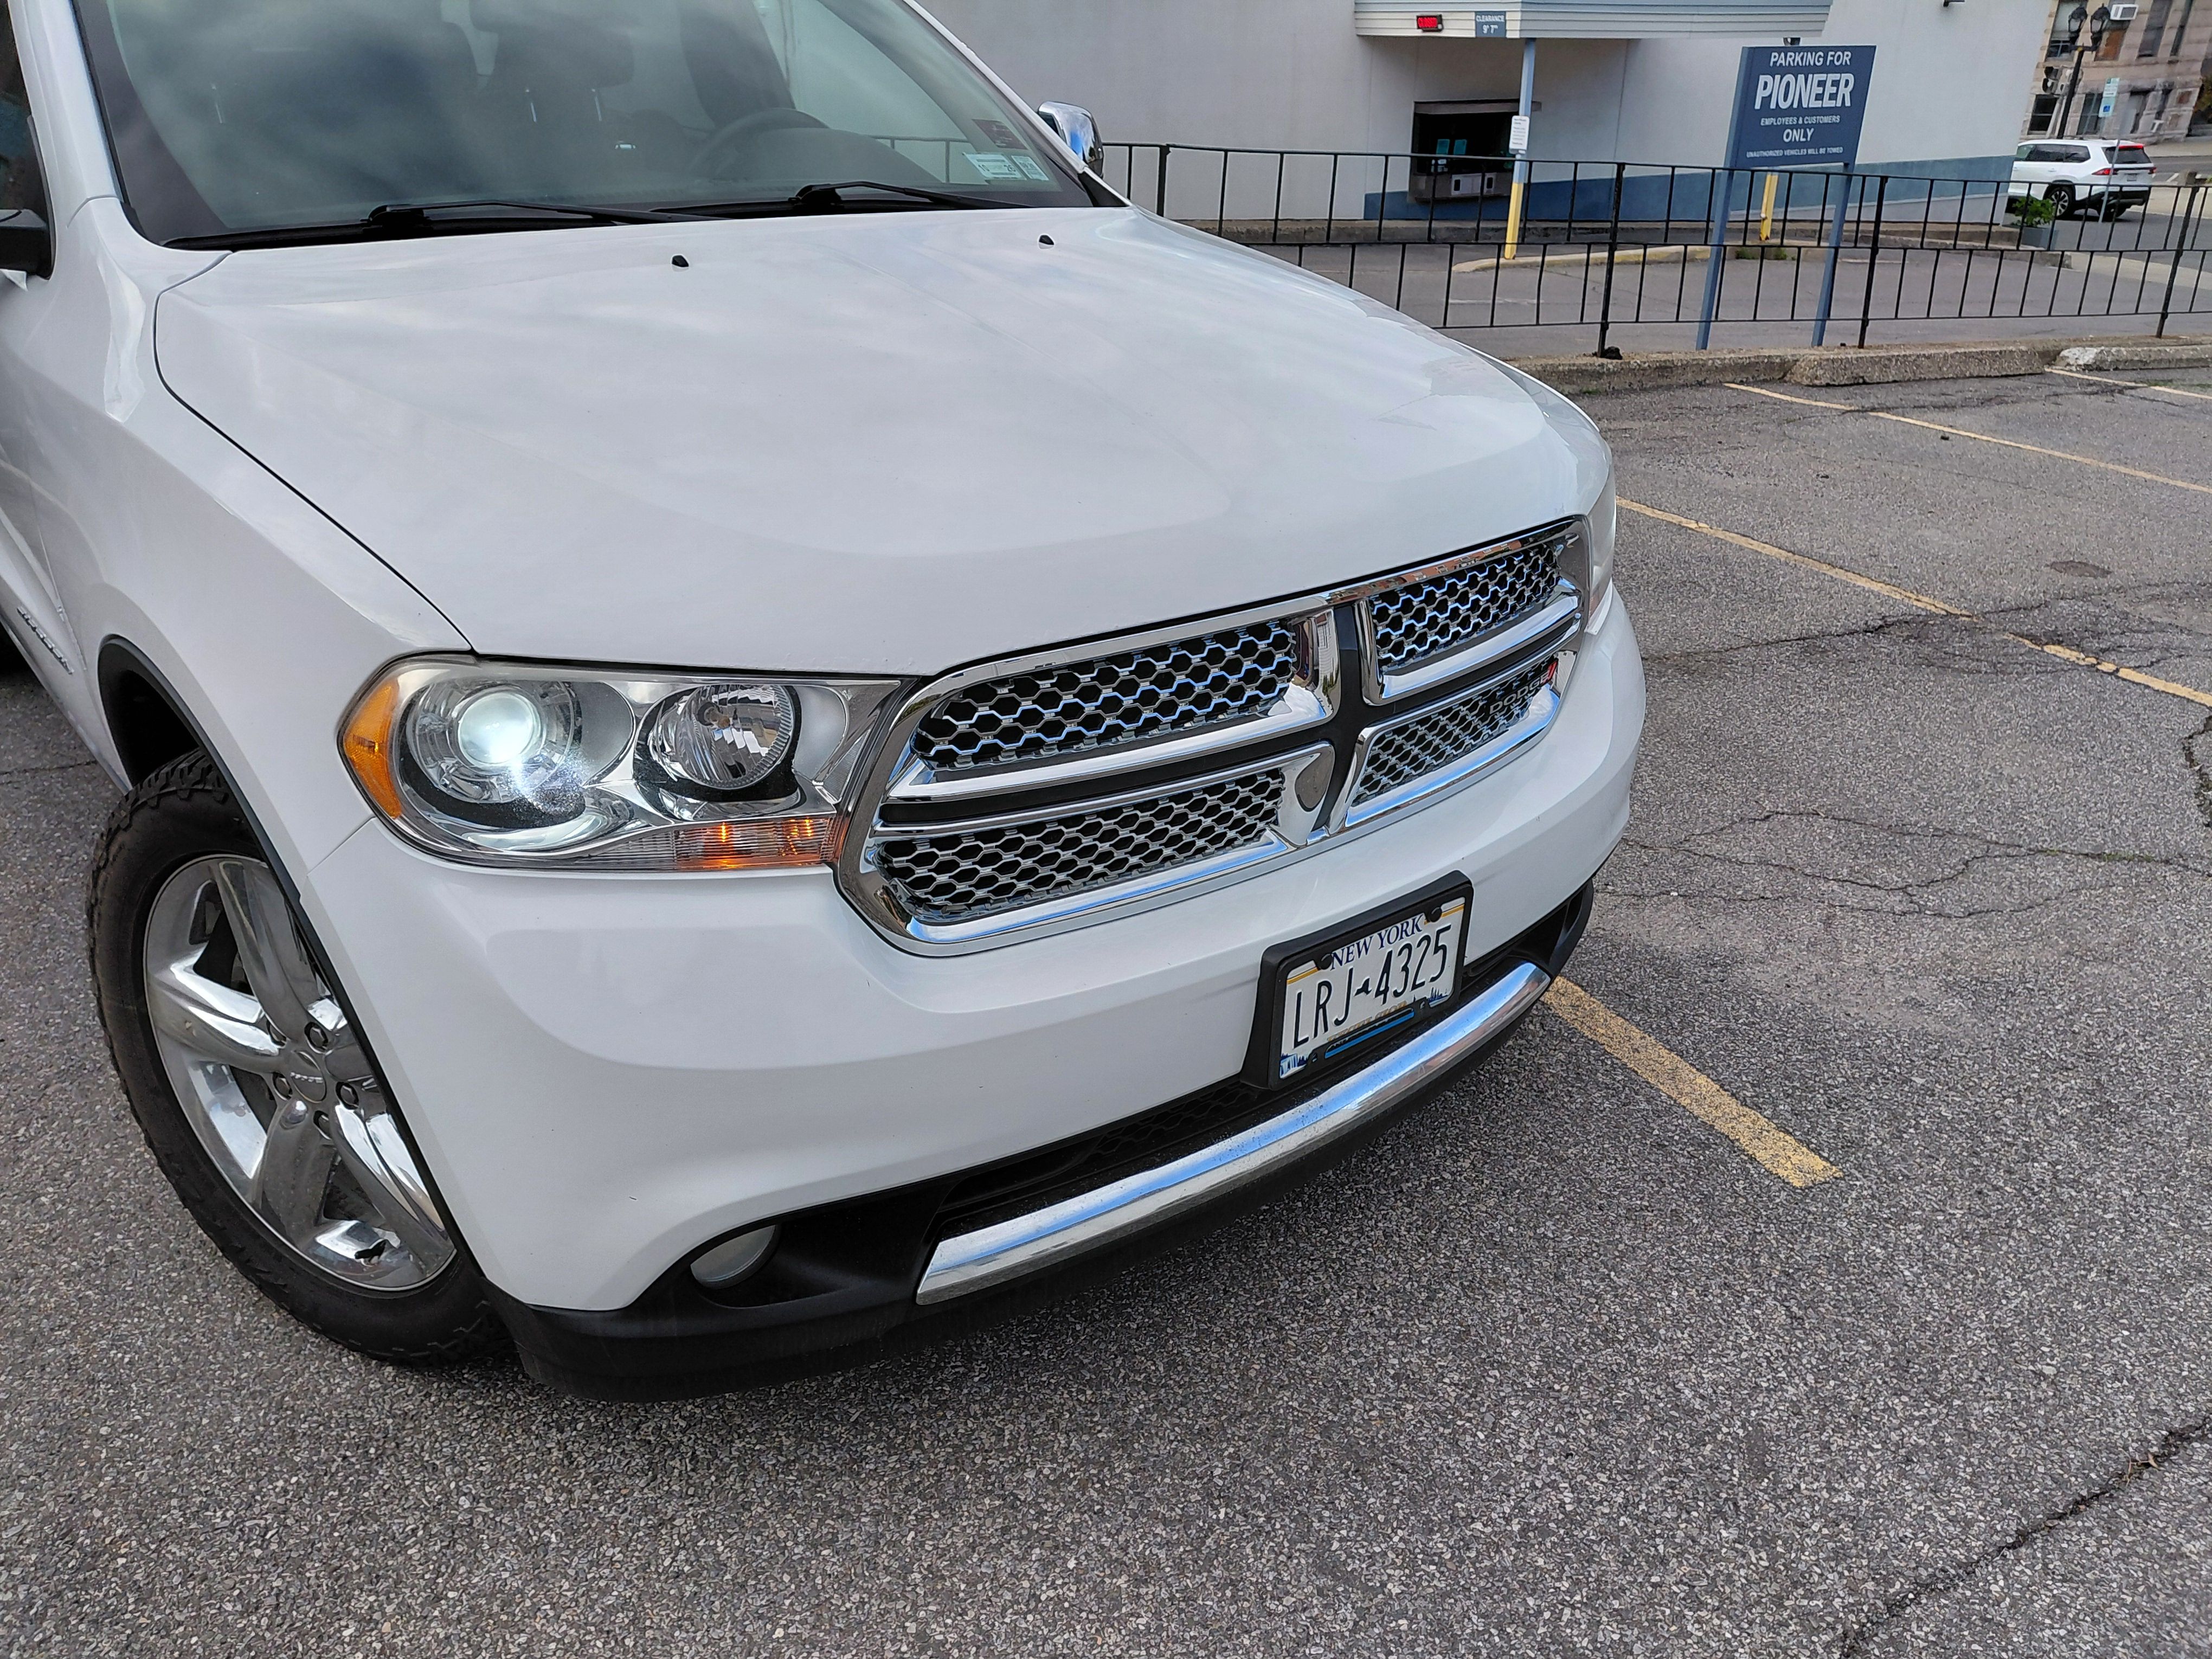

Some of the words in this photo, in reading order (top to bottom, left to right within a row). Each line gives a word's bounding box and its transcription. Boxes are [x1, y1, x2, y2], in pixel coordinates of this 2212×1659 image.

[1770, 52, 1823, 67] PARKING
[1826, 51, 1851, 66] FOR
[1754, 73, 1855, 110] PIONEER
[1760, 116, 1797, 126] EMPLOYEES
[1804, 115, 1841, 124] CUSTOMERS
[1783, 128, 1814, 143] ONLY
[1746, 150, 1783, 158] UNAUTHORIZED
[978, 164, 991, 172] 10
[1489, 671, 1549, 715] DODGE
[1331, 937, 1373, 970] NEW
[1377, 915, 1423, 950] YORK
